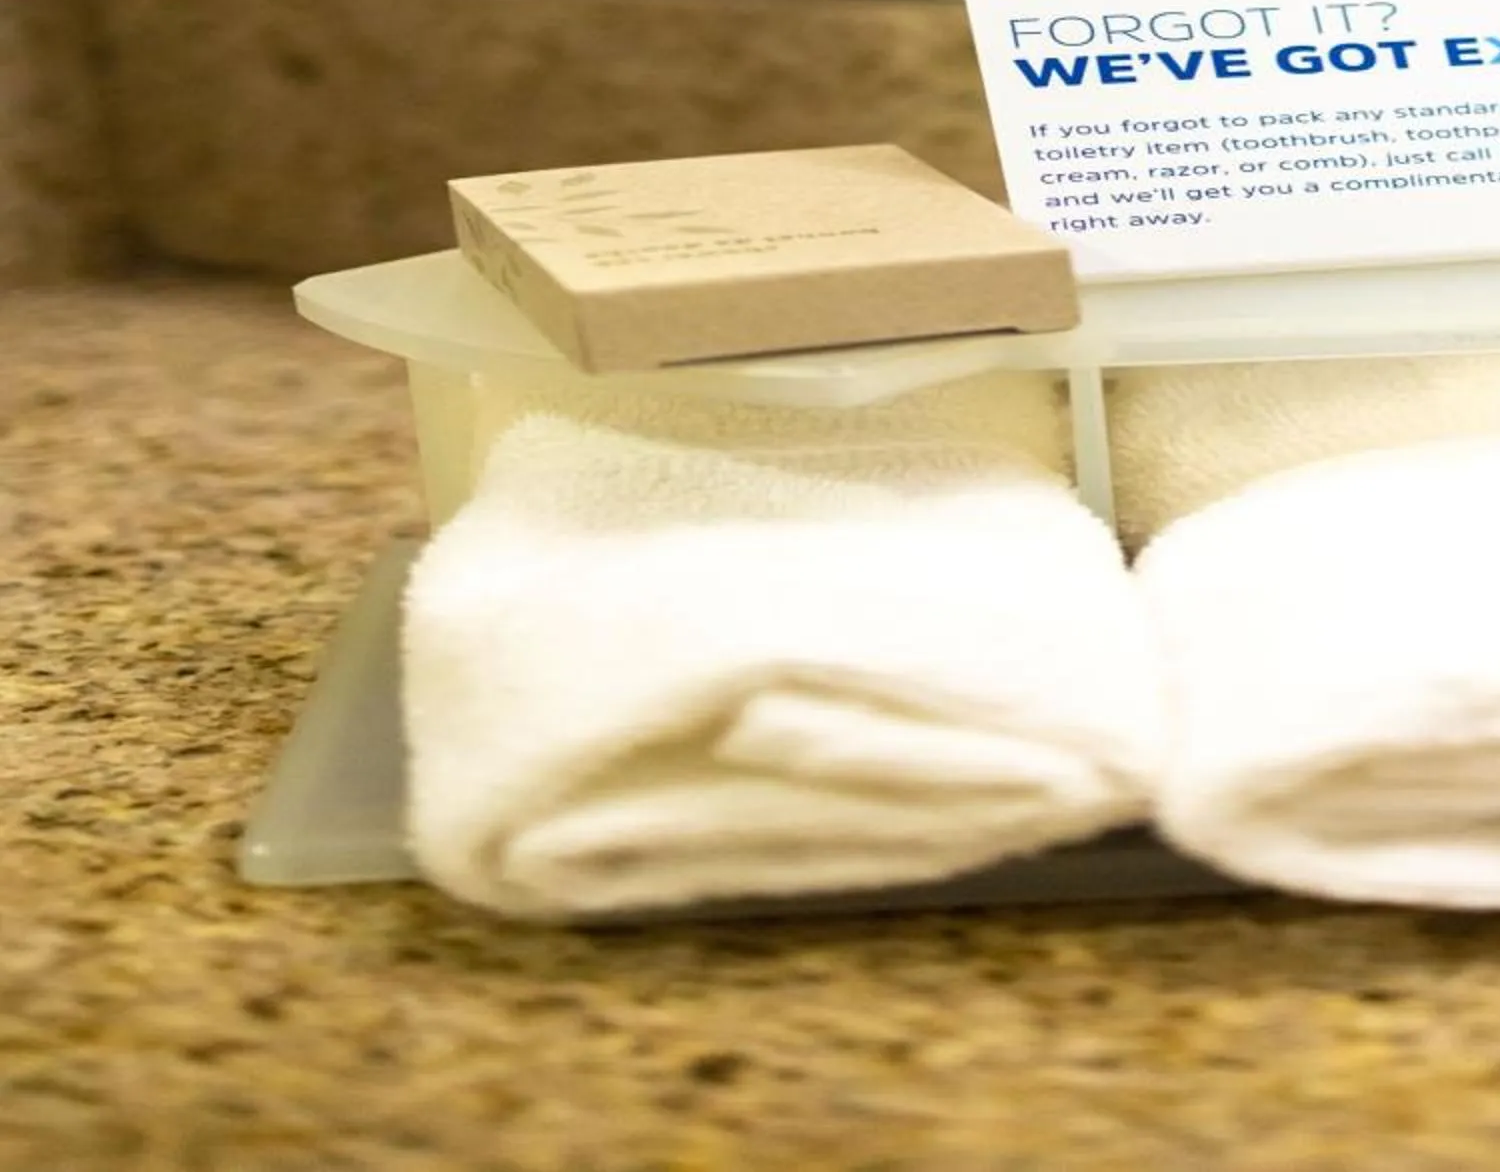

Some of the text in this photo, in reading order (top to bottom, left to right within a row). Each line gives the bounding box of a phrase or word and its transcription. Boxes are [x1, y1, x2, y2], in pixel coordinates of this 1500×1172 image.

[1009, 1, 1397, 49] FORGOT IT?
[1275, 42, 1416, 75] GOT
[1030, 123, 1047, 138] If
[1059, 122, 1110, 139] you
[1121, 116, 1210, 136] forgot
[1219, 115, 1248, 129] to
[1259, 110, 1324, 127] pack
[1336, 108, 1383, 123] any
[1034, 144, 1135, 161] toiletry
[1147, 140, 1209, 155] item
[1221, 130, 1396, 151] (toothbrush,
[1040, 168, 1136, 184] cream,
[1149, 163, 1228, 179] razor,
[1239, 160, 1266, 173] or
[1279, 153, 1376, 172] comb),
[1387, 151, 1435, 168] just
[1446, 148, 1491, 162] call
[1046, 193, 1099, 207] and
[1186, 186, 1231, 202] get
[1242, 182, 1293, 198] you
[1304, 182, 1319, 193] a
[1051, 210, 1211, 232] right away.
